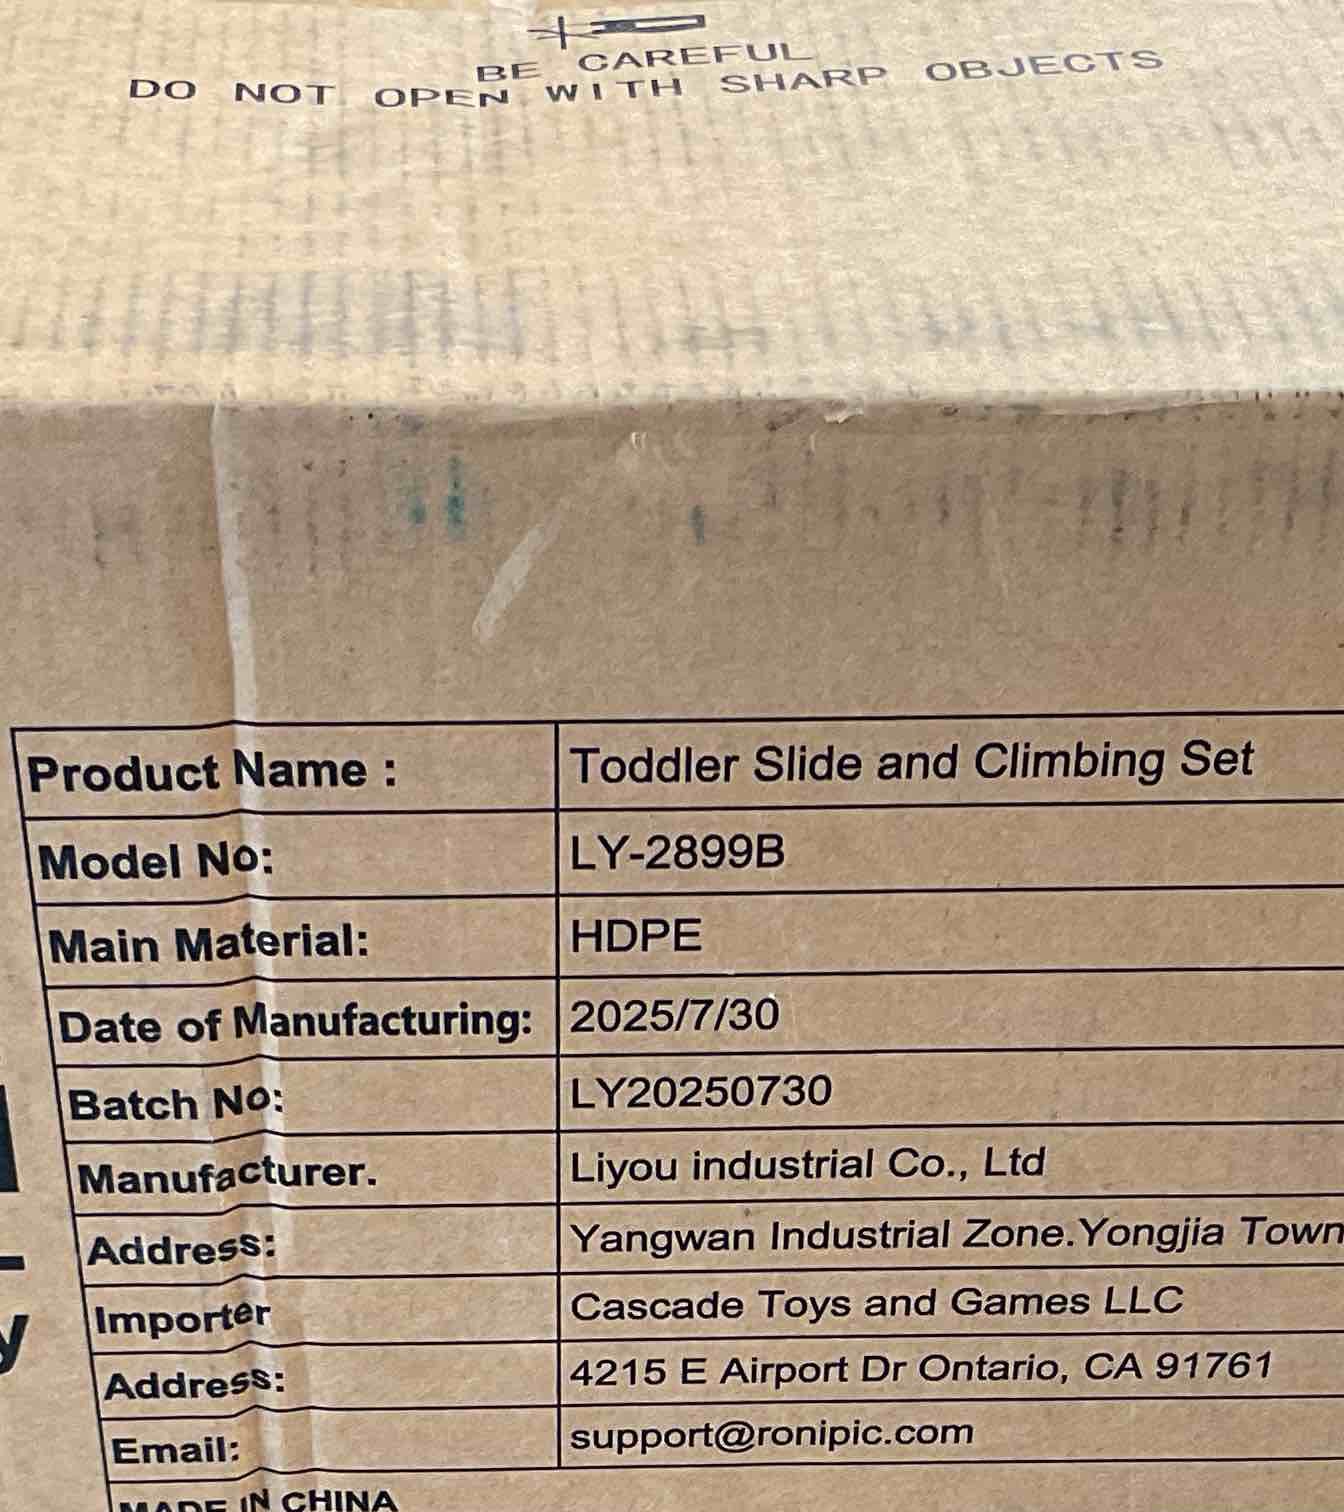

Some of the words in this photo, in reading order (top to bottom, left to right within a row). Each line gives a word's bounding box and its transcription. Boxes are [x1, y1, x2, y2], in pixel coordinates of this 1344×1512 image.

[129, 78, 196, 100] DO
[235, 82, 326, 105] NOT
[374, 87, 509, 108] OPEN
[545, 77, 682, 102] WITH
[720, 66, 887, 94] SHARP
[925, 49, 1163, 82] OBJECTS
[476, 62, 536, 82] BE
[578, 42, 813, 72] CAREFUL
[27, 754, 221, 793] Product
[233, 748, 367, 788] Name
[569, 746, 740, 784] Toddler
[754, 744, 862, 782] Slide
[877, 743, 959, 781] and
[975, 740, 1165, 786] Climbing
[1180, 739, 1255, 776] Set
[38, 843, 181, 880] Model
[197, 840, 273, 878] No:
[572, 833, 785, 870] LY-2899B
[48, 928, 159, 964] Main
[175, 922, 368, 962] Material:
[572, 918, 702, 953] HDPE
[58, 1011, 162, 1044] Date
[177, 1008, 222, 1043] of
[233, 1001, 532, 1039] Manufacturing:
[570, 997, 779, 1033] 2025/7/30
[68, 1088, 198, 1121] Batch
[213, 1084, 283, 1119] No:
[572, 1074, 832, 1109] LY20250730
[77, 1155, 377, 1195] Manufacturer.
[572, 1151, 677, 1190] Liyou
[693, 1148, 874, 1181] industrial
[888, 1147, 967, 1182] Co.,
[984, 1146, 1046, 1177] Ltd
[87, 1233, 275, 1266] Address:
[570, 1224, 755, 1259] Yangwan
[771, 1219, 950, 1250] Industrial
[95, 1301, 271, 1340] Importer
[571, 1290, 744, 1321] Cascade
[757, 1289, 851, 1325] Toys
[864, 1287, 937, 1317] and
[951, 1287, 1090, 1316] Games
[1104, 1285, 1184, 1315] LLC
[103, 1368, 285, 1401] Address:
[569, 1358, 666, 1386] 4215
[681, 1357, 707, 1385] E
[719, 1356, 849, 1390] Airport
[861, 1355, 908, 1382] Dr
[919, 1353, 1068, 1385] Ontario,
[1085, 1352, 1143, 1380] CA
[1156, 1351, 1271, 1380] 91761
[111, 1436, 239, 1464] Email:
[570, 1419, 974, 1455] support@ronipic.com
